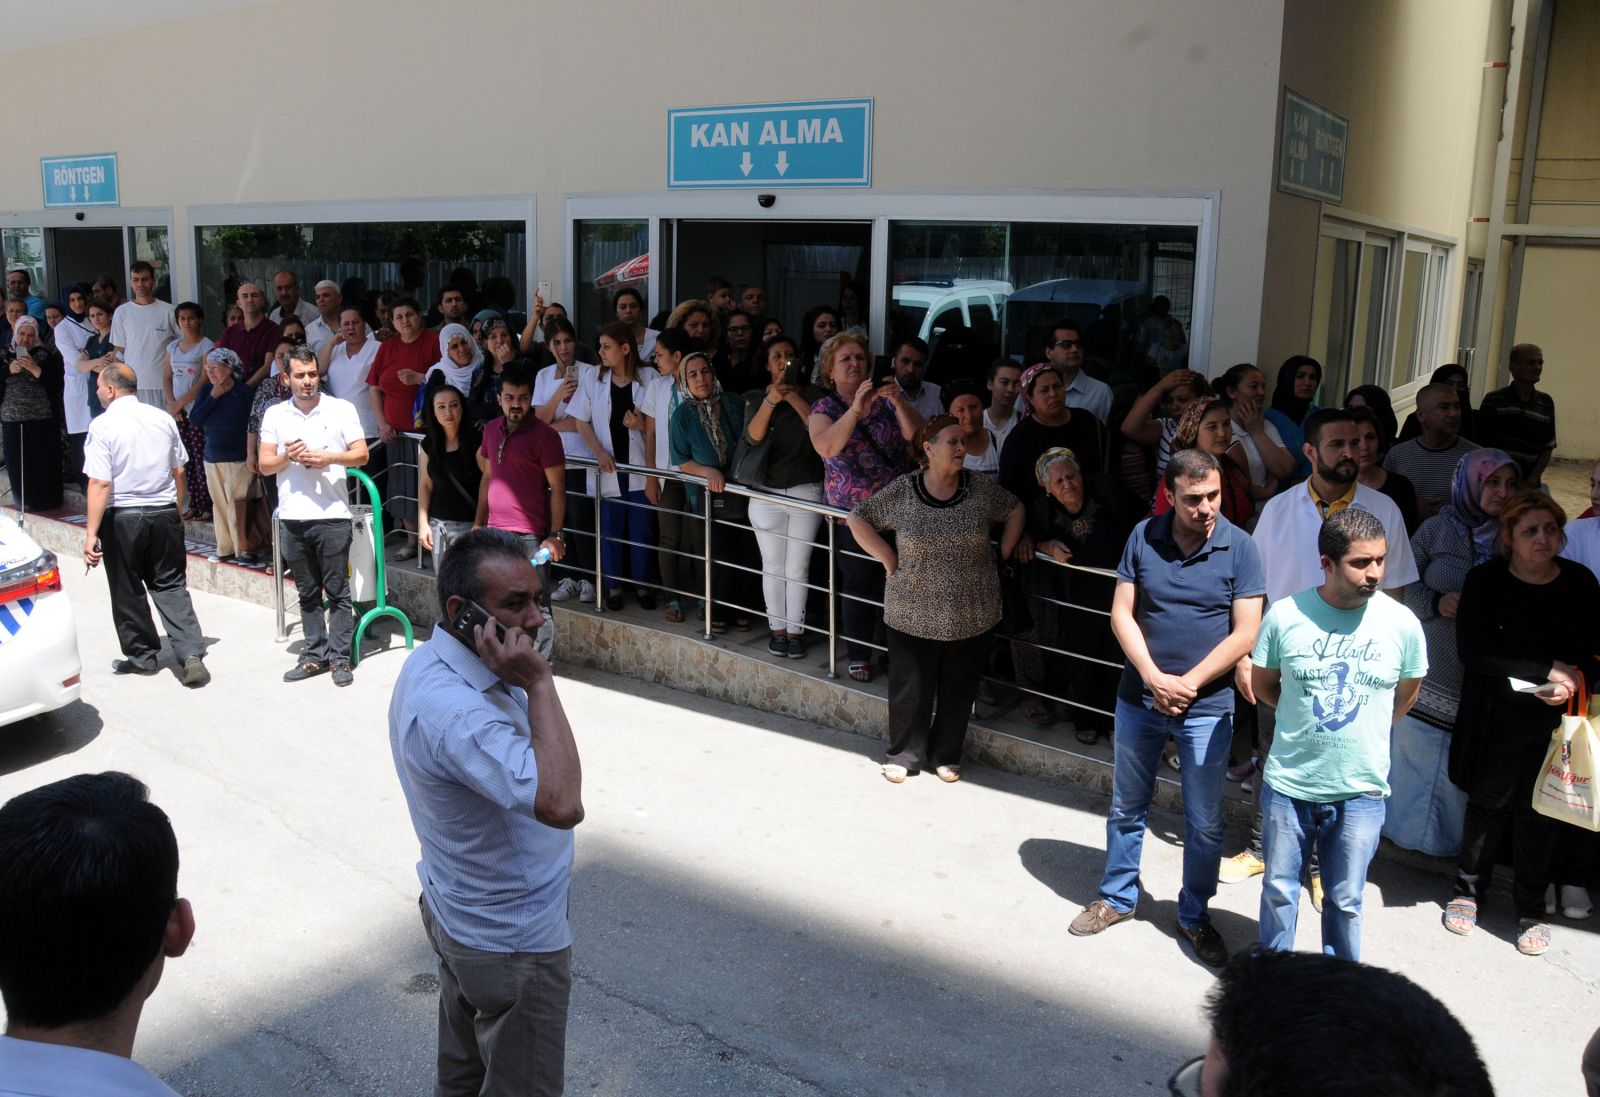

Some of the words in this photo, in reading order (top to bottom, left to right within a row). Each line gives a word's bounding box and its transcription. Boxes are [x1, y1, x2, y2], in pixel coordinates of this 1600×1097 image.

[690, 121, 749, 148] KAN
[758, 117, 843, 145] ALMA
[54, 165, 105, 186] RÖNTGEN
[1310, 629, 1382, 664] Atlantic
[1291, 668, 1323, 681] COAST
[1358, 694, 1369, 706] 03
